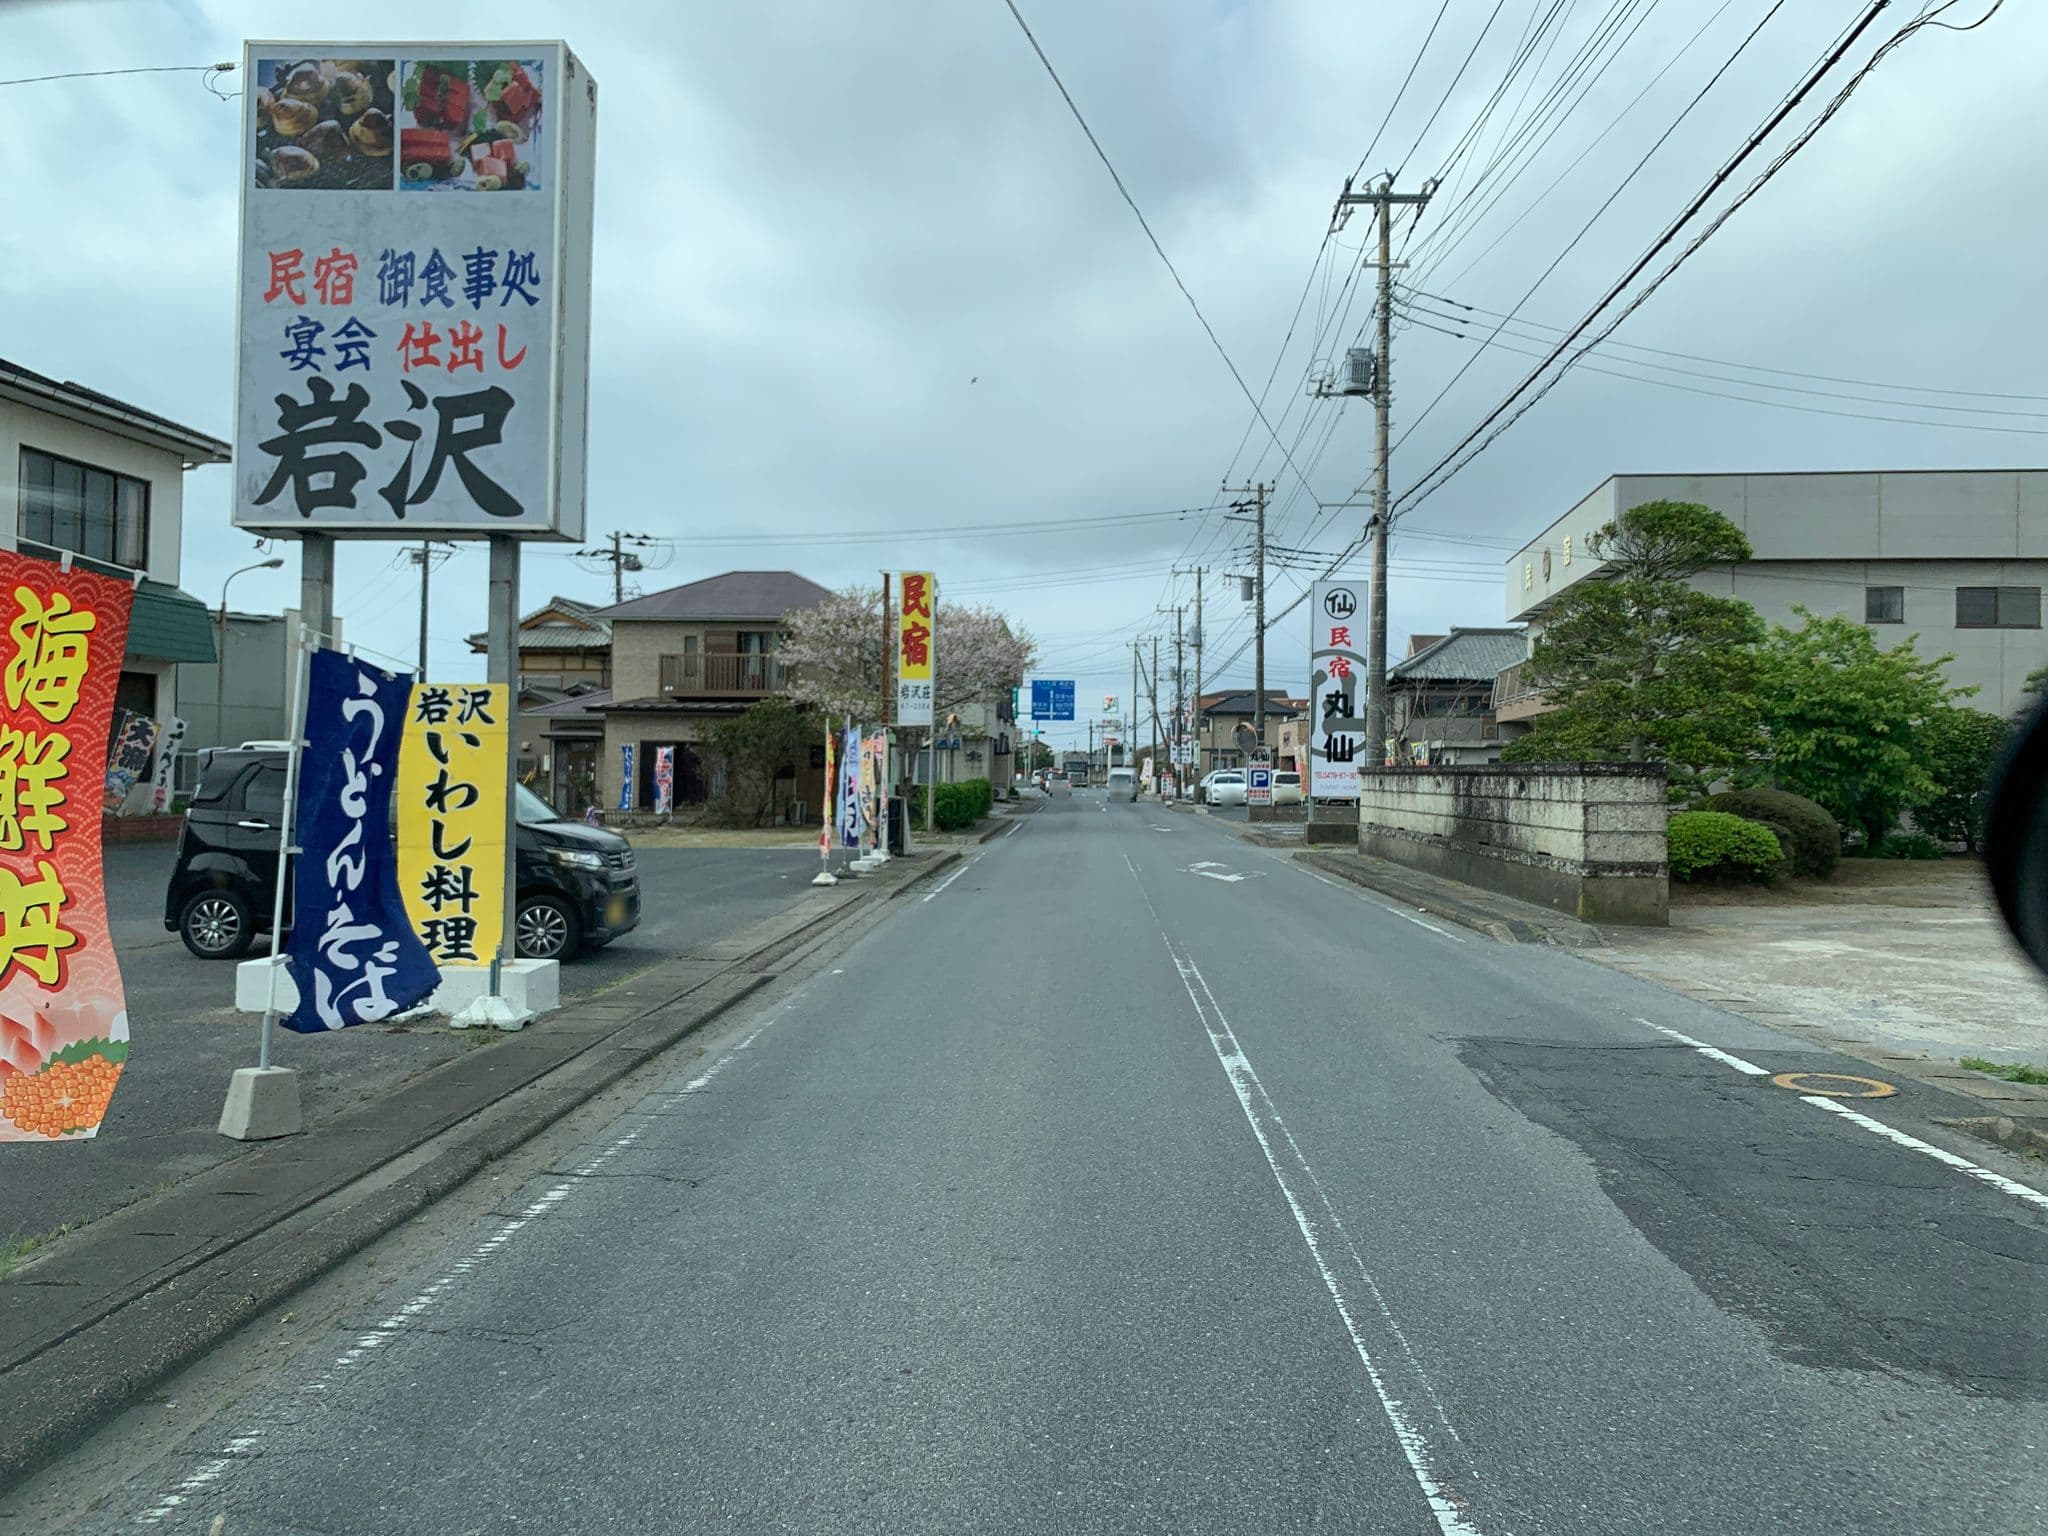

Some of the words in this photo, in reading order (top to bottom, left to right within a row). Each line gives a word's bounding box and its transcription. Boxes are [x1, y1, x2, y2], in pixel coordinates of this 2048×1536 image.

[264, 247, 359, 306] 民宿
[376, 245, 541, 310] 御食事処
[279, 315, 378, 373] 宴会
[396, 319, 528, 374] 仕出し
[252, 375, 525, 520] 岩沢
[901, 574, 931, 668] 民宿
[1328, 625, 1352, 679] 民宿
[416, 687, 496, 725] 岩沢
[900, 683, 931, 700] 岩沢荘
[1324, 689, 1355, 764] 丸仙
[0, 585, 96, 986] 海鮮丼
[417, 731, 482, 962] いわし料理
